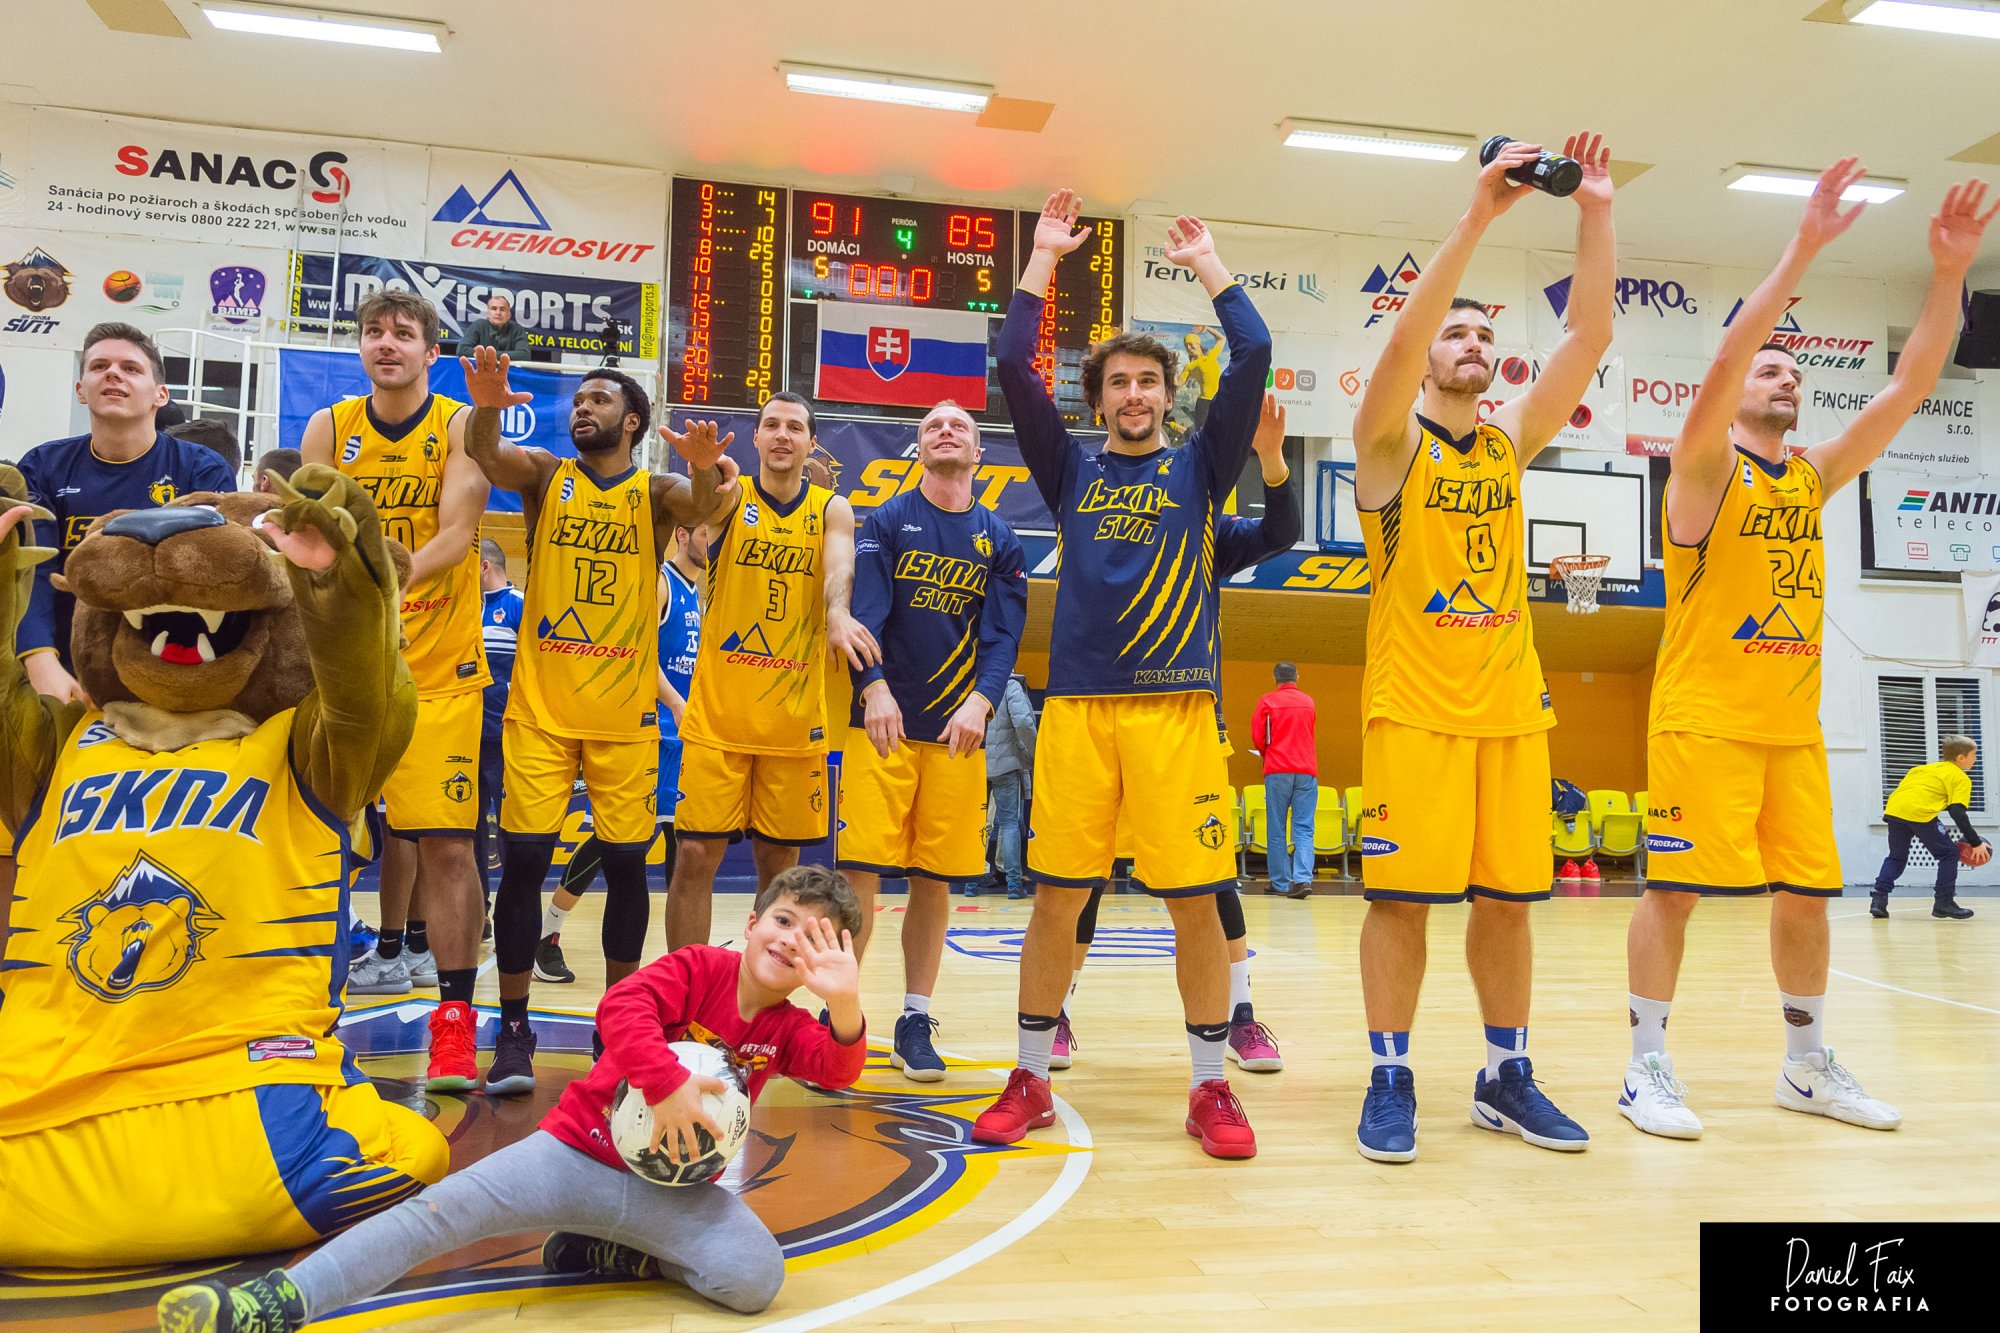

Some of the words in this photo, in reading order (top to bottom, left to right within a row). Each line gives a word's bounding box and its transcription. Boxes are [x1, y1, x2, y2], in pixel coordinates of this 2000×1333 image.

[114, 144, 297, 190] SANAC
[49, 184, 104, 200] Sanácia
[107, 192, 126, 203] po
[129, 193, 198, 209] požiaroch
[202, 201, 210, 210] a
[214, 201, 271, 215] škodách
[367, 215, 407, 228] vodou
[701, 184, 713, 200] 0
[758, 190, 775, 206] 14
[47, 201, 64, 211] 24
[76, 203, 142, 220] hodinový
[145, 212, 188, 223] servis
[191, 214, 223, 226] 0800
[226, 216, 250, 229] 222
[254, 219, 281, 232] 221,
[702, 202, 713, 218] 3
[765, 207, 775, 223] 7
[813, 202, 861, 236] 91
[892, 217, 918, 227] PERIÓDA
[701, 221, 712, 236] 4
[757, 226, 775, 242] 10
[896, 229, 912, 250] 4
[949, 215, 995, 249] 85
[1097, 221, 1113, 237] 13
[450, 228, 655, 263] CHEMOSVIT
[700, 239, 711, 255] 8
[749, 242, 773, 260] 25
[807, 240, 860, 256] DOMÁCI
[1102, 238, 1113, 255] 0
[694, 257, 711, 273] 10
[762, 262, 773, 279] 5
[947, 251, 995, 267] HOSTIA
[1090, 255, 1113, 272] 23
[693, 275, 710, 291] 11
[761, 280, 773, 297] 0
[1101, 273, 1113, 289] 0
[693, 293, 710, 309] 12
[760, 298, 773, 315] 8
[1101, 290, 1113, 306] 2
[217, 306, 258, 317] BAMP
[692, 311, 710, 328] 13
[760, 316, 772, 333] 0
[1101, 307, 1113, 323] 0
[3, 318, 60, 334] SVIT
[546, 336, 555, 347] A
[691, 330, 709, 346] 14
[760, 334, 772, 351] 0
[683, 347, 709, 365] 20
[759, 352, 771, 369] 0
[683, 366, 708, 383] 24
[746, 370, 771, 388] 22
[683, 384, 708, 401] 27
[1946, 424, 1974, 435] s.r.o.
[1888, 450, 1936, 463] finančných
[1938, 453, 1970, 464] služieb
[1466, 522, 1497, 573] 8
[574, 558, 618, 606] 12
[894, 550, 988, 597] ISKRA
[1767, 548, 1823, 599] 24
[765, 579, 788, 622] 3
[909, 586, 974, 615] SVIT
[52, 768, 270, 847] ISKRA
[730, 1105, 742, 1147] adidas
